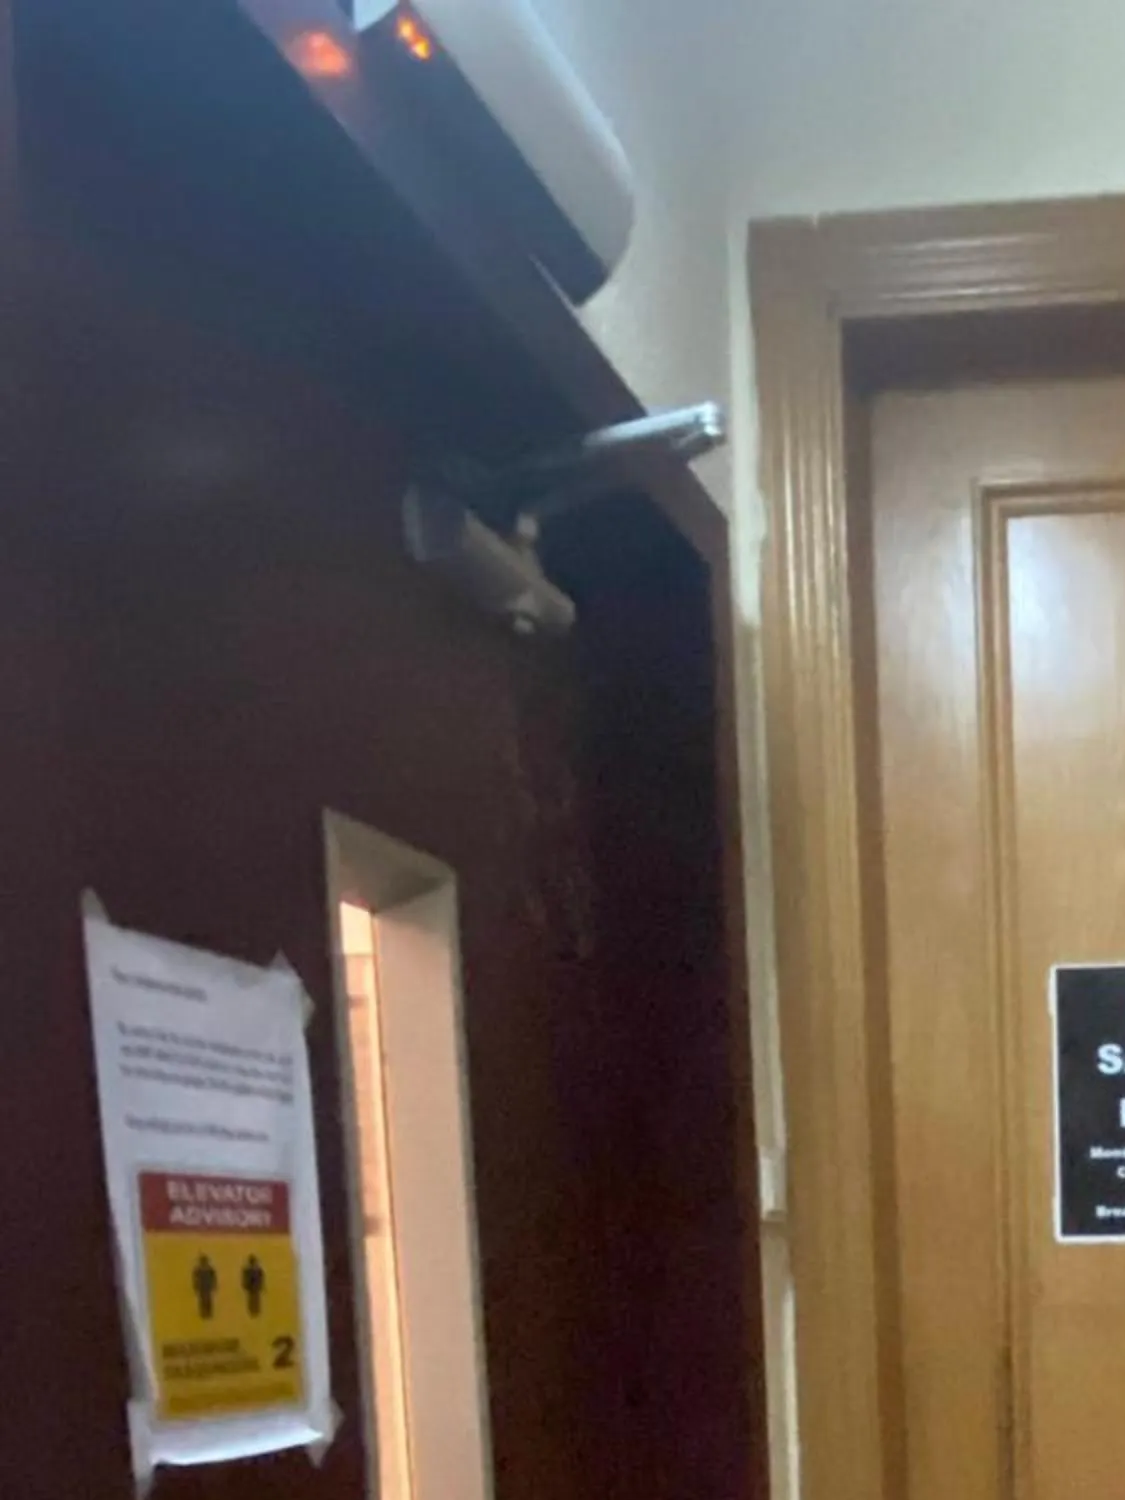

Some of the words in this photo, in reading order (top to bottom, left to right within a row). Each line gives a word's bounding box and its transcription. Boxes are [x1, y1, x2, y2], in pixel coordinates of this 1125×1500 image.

[167, 1180, 273, 1205] ELEVATOR
[170, 1205, 272, 1229] ADVISORY
[271, 1336, 296, 1369] 2
